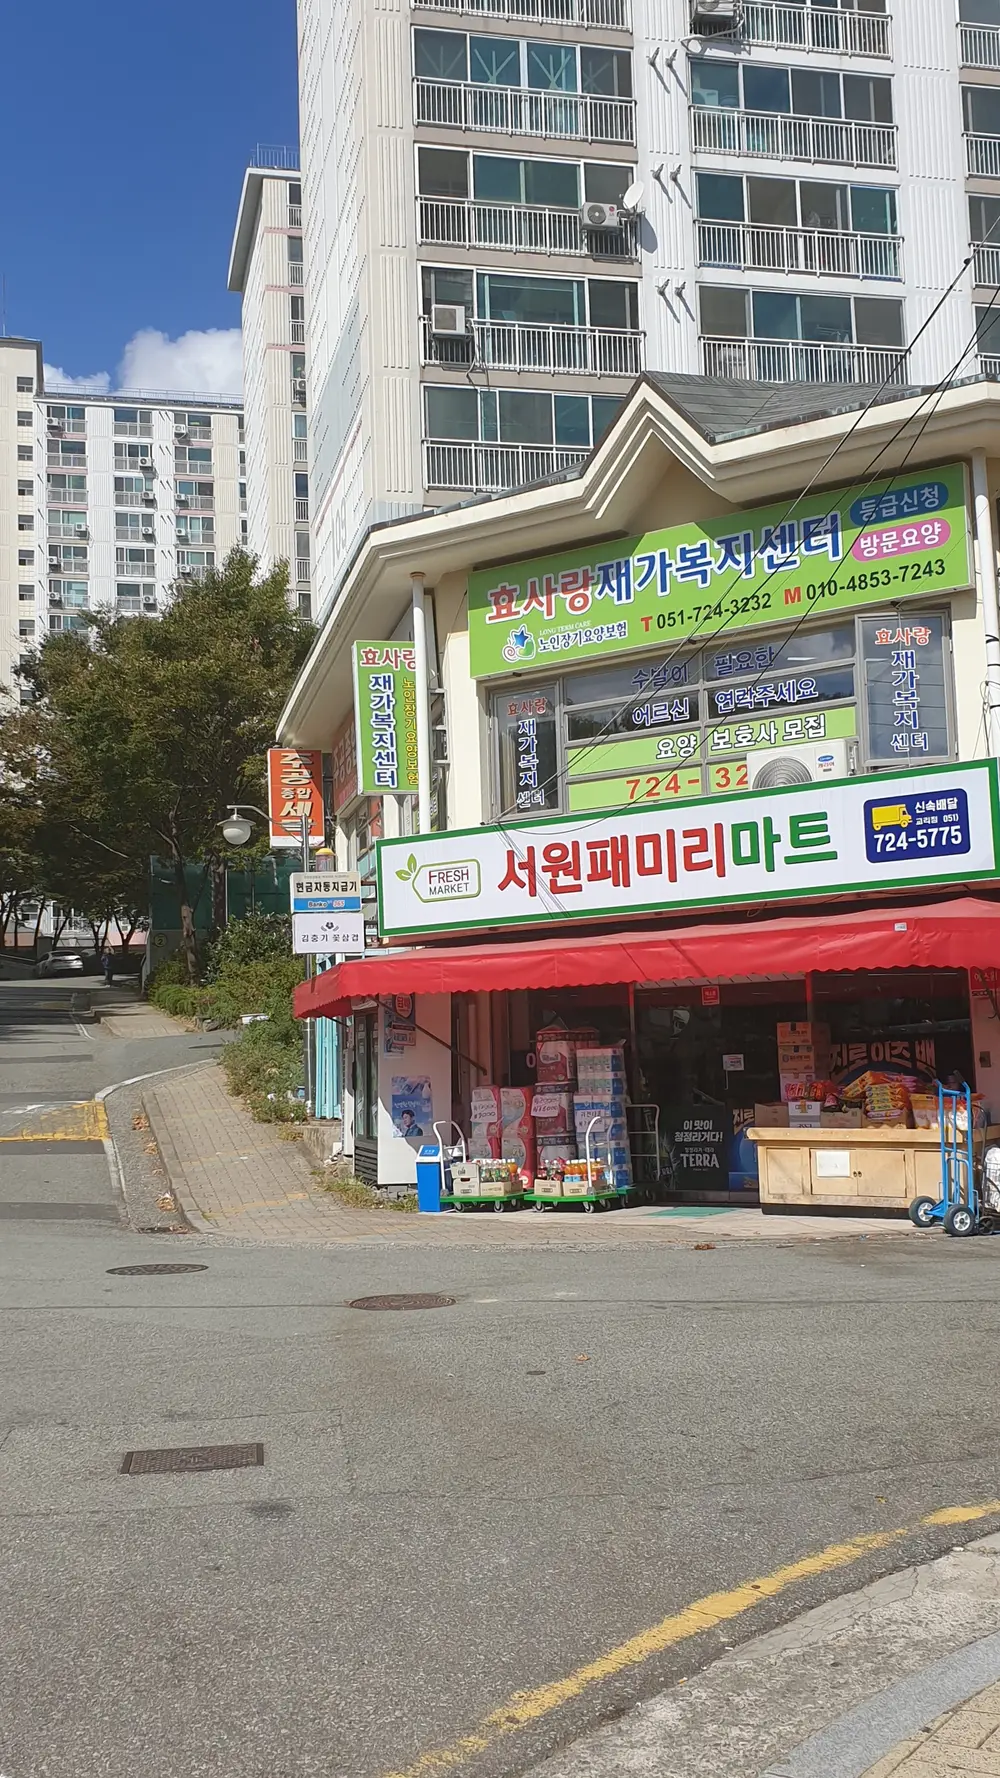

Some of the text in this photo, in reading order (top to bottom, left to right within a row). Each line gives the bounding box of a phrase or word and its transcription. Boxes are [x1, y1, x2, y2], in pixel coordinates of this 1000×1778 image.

[859, 485, 940, 522] 등급신청
[860, 522, 942, 556] 방문요양
[641, 559, 946, 632] T 051-724-3232 M 010-4853-7243
[539, 622, 627, 651] 노인장기요양보험
[875, 627, 931, 646] 효사랑
[632, 647, 775, 689] 수발이 필요한
[507, 697, 548, 716] 효사랑
[632, 678, 818, 727] 어르신 연락주세요
[369, 674, 396, 787] 재가복지센터
[656, 713, 826, 759] 요양 보호사 모집
[915, 797, 958, 814] 신속배달
[943, 813, 959, 823] 051)
[873, 825, 962, 853] 724-5775
[498, 811, 838, 897] 서원패미리마트
[296, 881, 357, 893] 현금자동지급기
[429, 867, 469, 884] FRESH
[429, 883, 469, 895] MARKET
[683, 1119, 713, 1130] 이 맛이
[674, 1131, 723, 1142] 청정라거다!
[680, 1153, 720, 1168] TERRA
